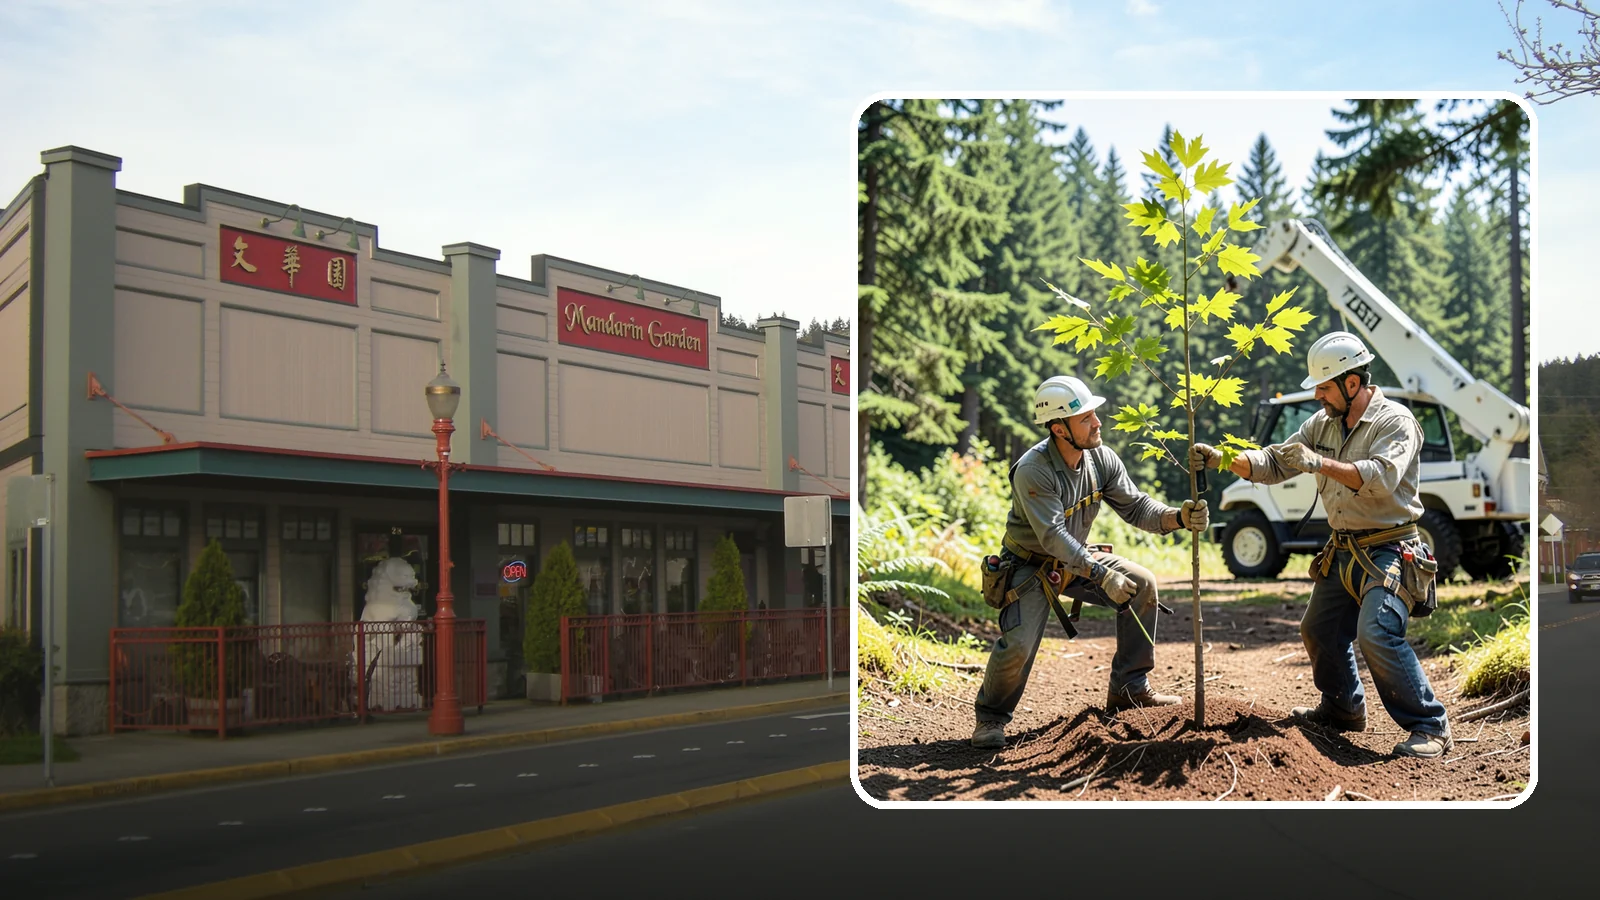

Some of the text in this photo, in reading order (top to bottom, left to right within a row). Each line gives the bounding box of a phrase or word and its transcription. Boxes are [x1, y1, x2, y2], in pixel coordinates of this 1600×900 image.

[231, 236, 346, 291] 文華園
[564, 302, 702, 352] Mandarin Garden
[503, 565, 527, 578] OPEN
